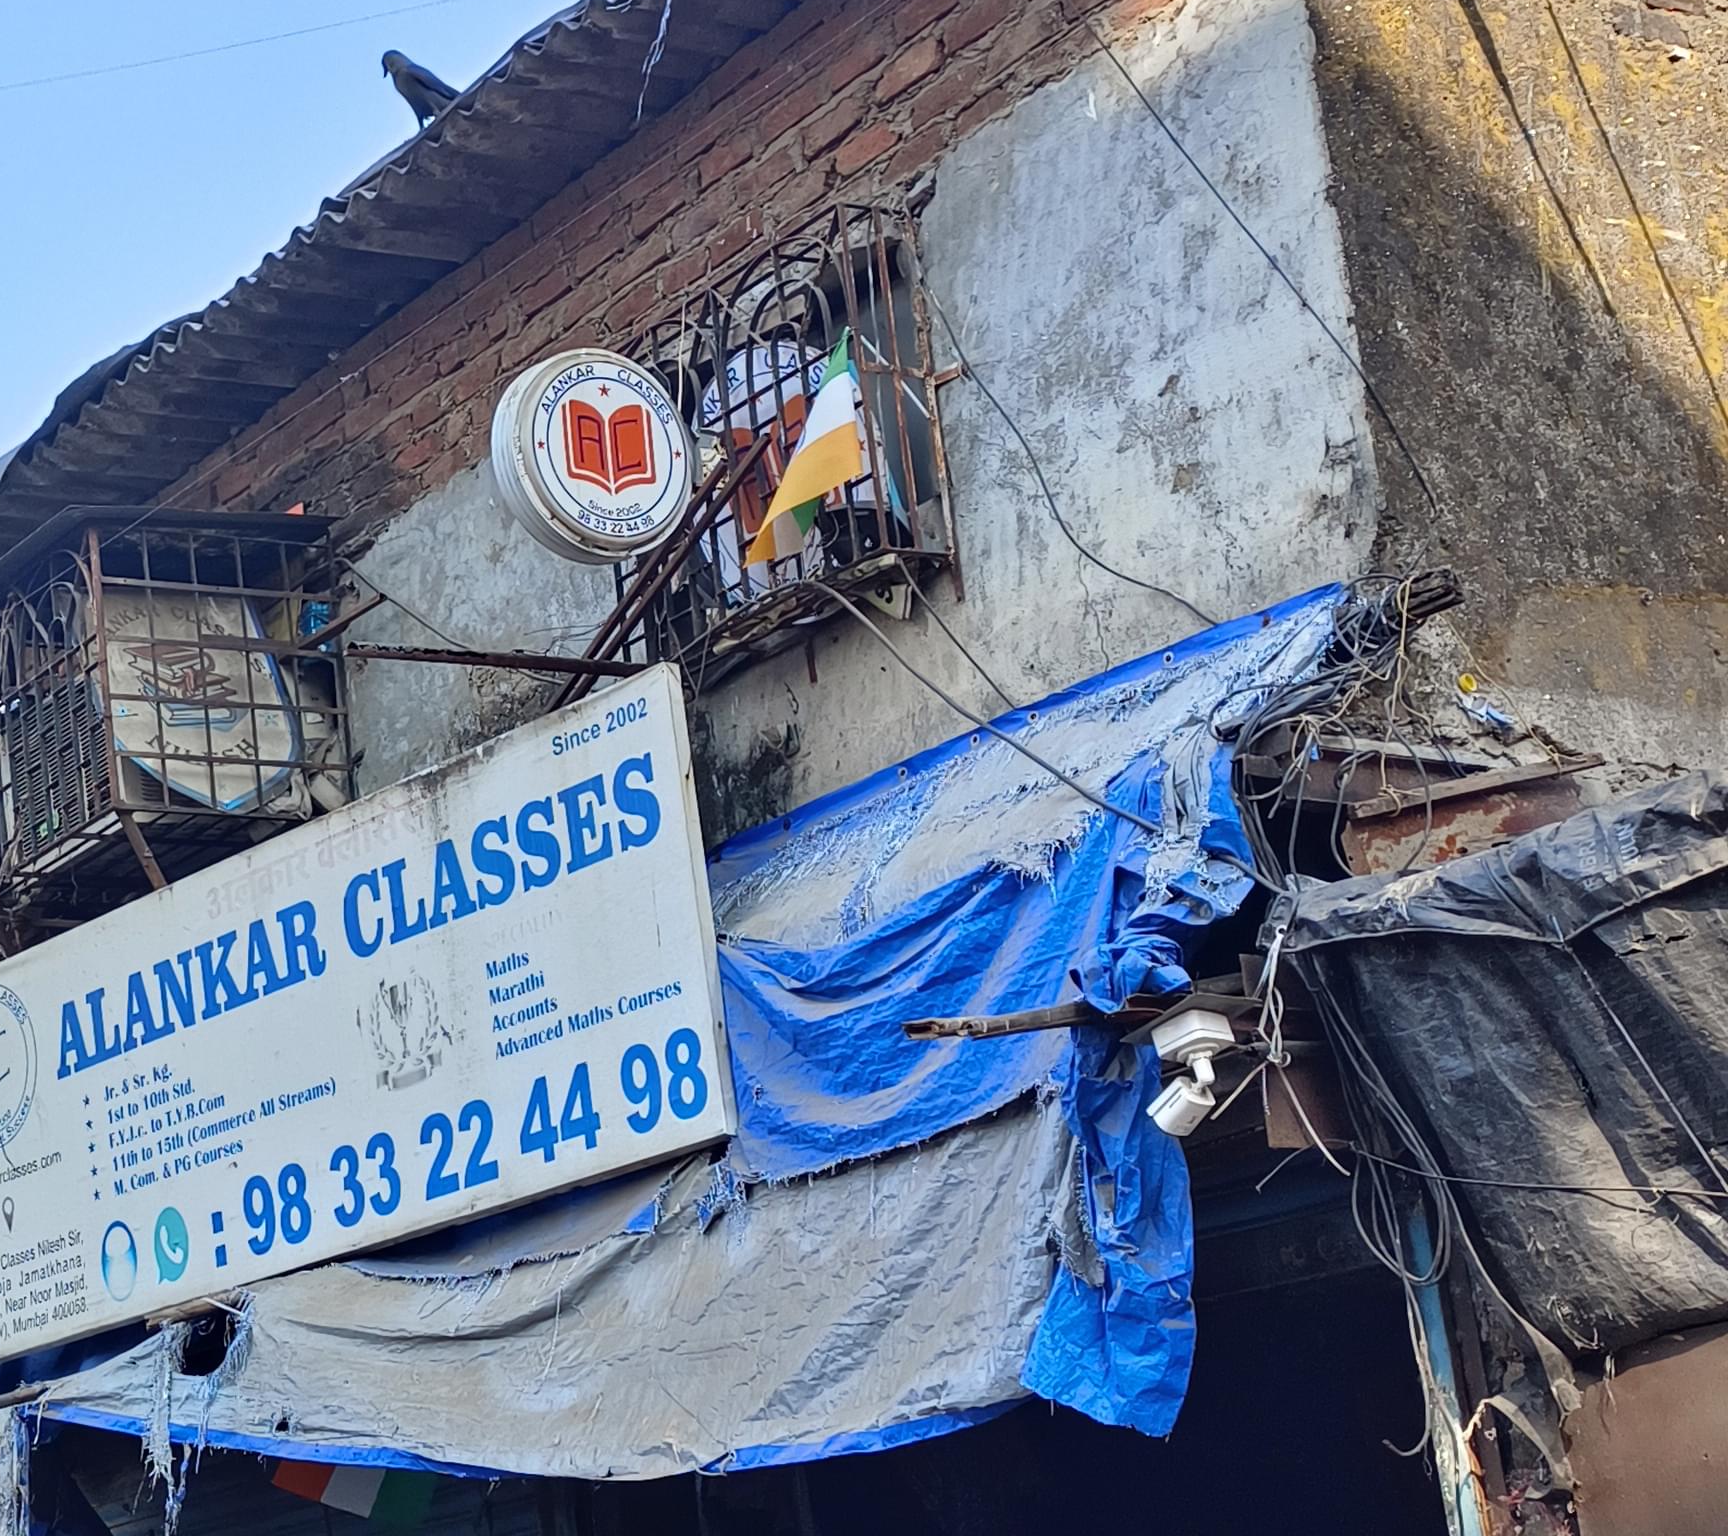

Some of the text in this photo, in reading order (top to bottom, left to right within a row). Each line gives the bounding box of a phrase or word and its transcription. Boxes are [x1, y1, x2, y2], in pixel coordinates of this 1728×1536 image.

[540, 364, 595, 415] ALANKAR
[616, 369, 674, 425] CLASSES
[551, 695, 650, 757] Since 2002
[56, 751, 663, 1081] ALANKAR CLASSES
[485, 951, 530, 979] Maths
[488, 970, 546, 1006] Marathi
[491, 995, 559, 1033] Accounts
[495, 979, 683, 1060] Advanced Maths Courses
[103, 1084, 119, 1102] Jr.
[132, 1072, 150, 1089] Sr.
[152, 1063, 174, 1082] Kg.
[107, 1077, 196, 1125] 1st to 10th Std.
[112, 1076, 337, 1172] 11th to 15th (Commerce All Streams)
[150, 1118, 162, 1133] to
[166, 1094, 226, 1127] T.Y.B.Com
[242, 1162, 312, 1256] 98
[329, 1131, 402, 1229] 33
[419, 1098, 499, 1202] 22
[519, 1061, 602, 1163] 44
[619, 1026, 709, 1135] 98
[114, 1139, 244, 1197] M. Com. & PG Courses
[0, 1247, 36, 1271] Classes
[68, 1228, 84, 1247] Sir,
[18, 1254, 87, 1288] Jamatkhana,
[5, 1293, 28, 1313] Near
[29, 1286, 53, 1306] Noor
[12, 1308, 50, 1334] Mumbai
